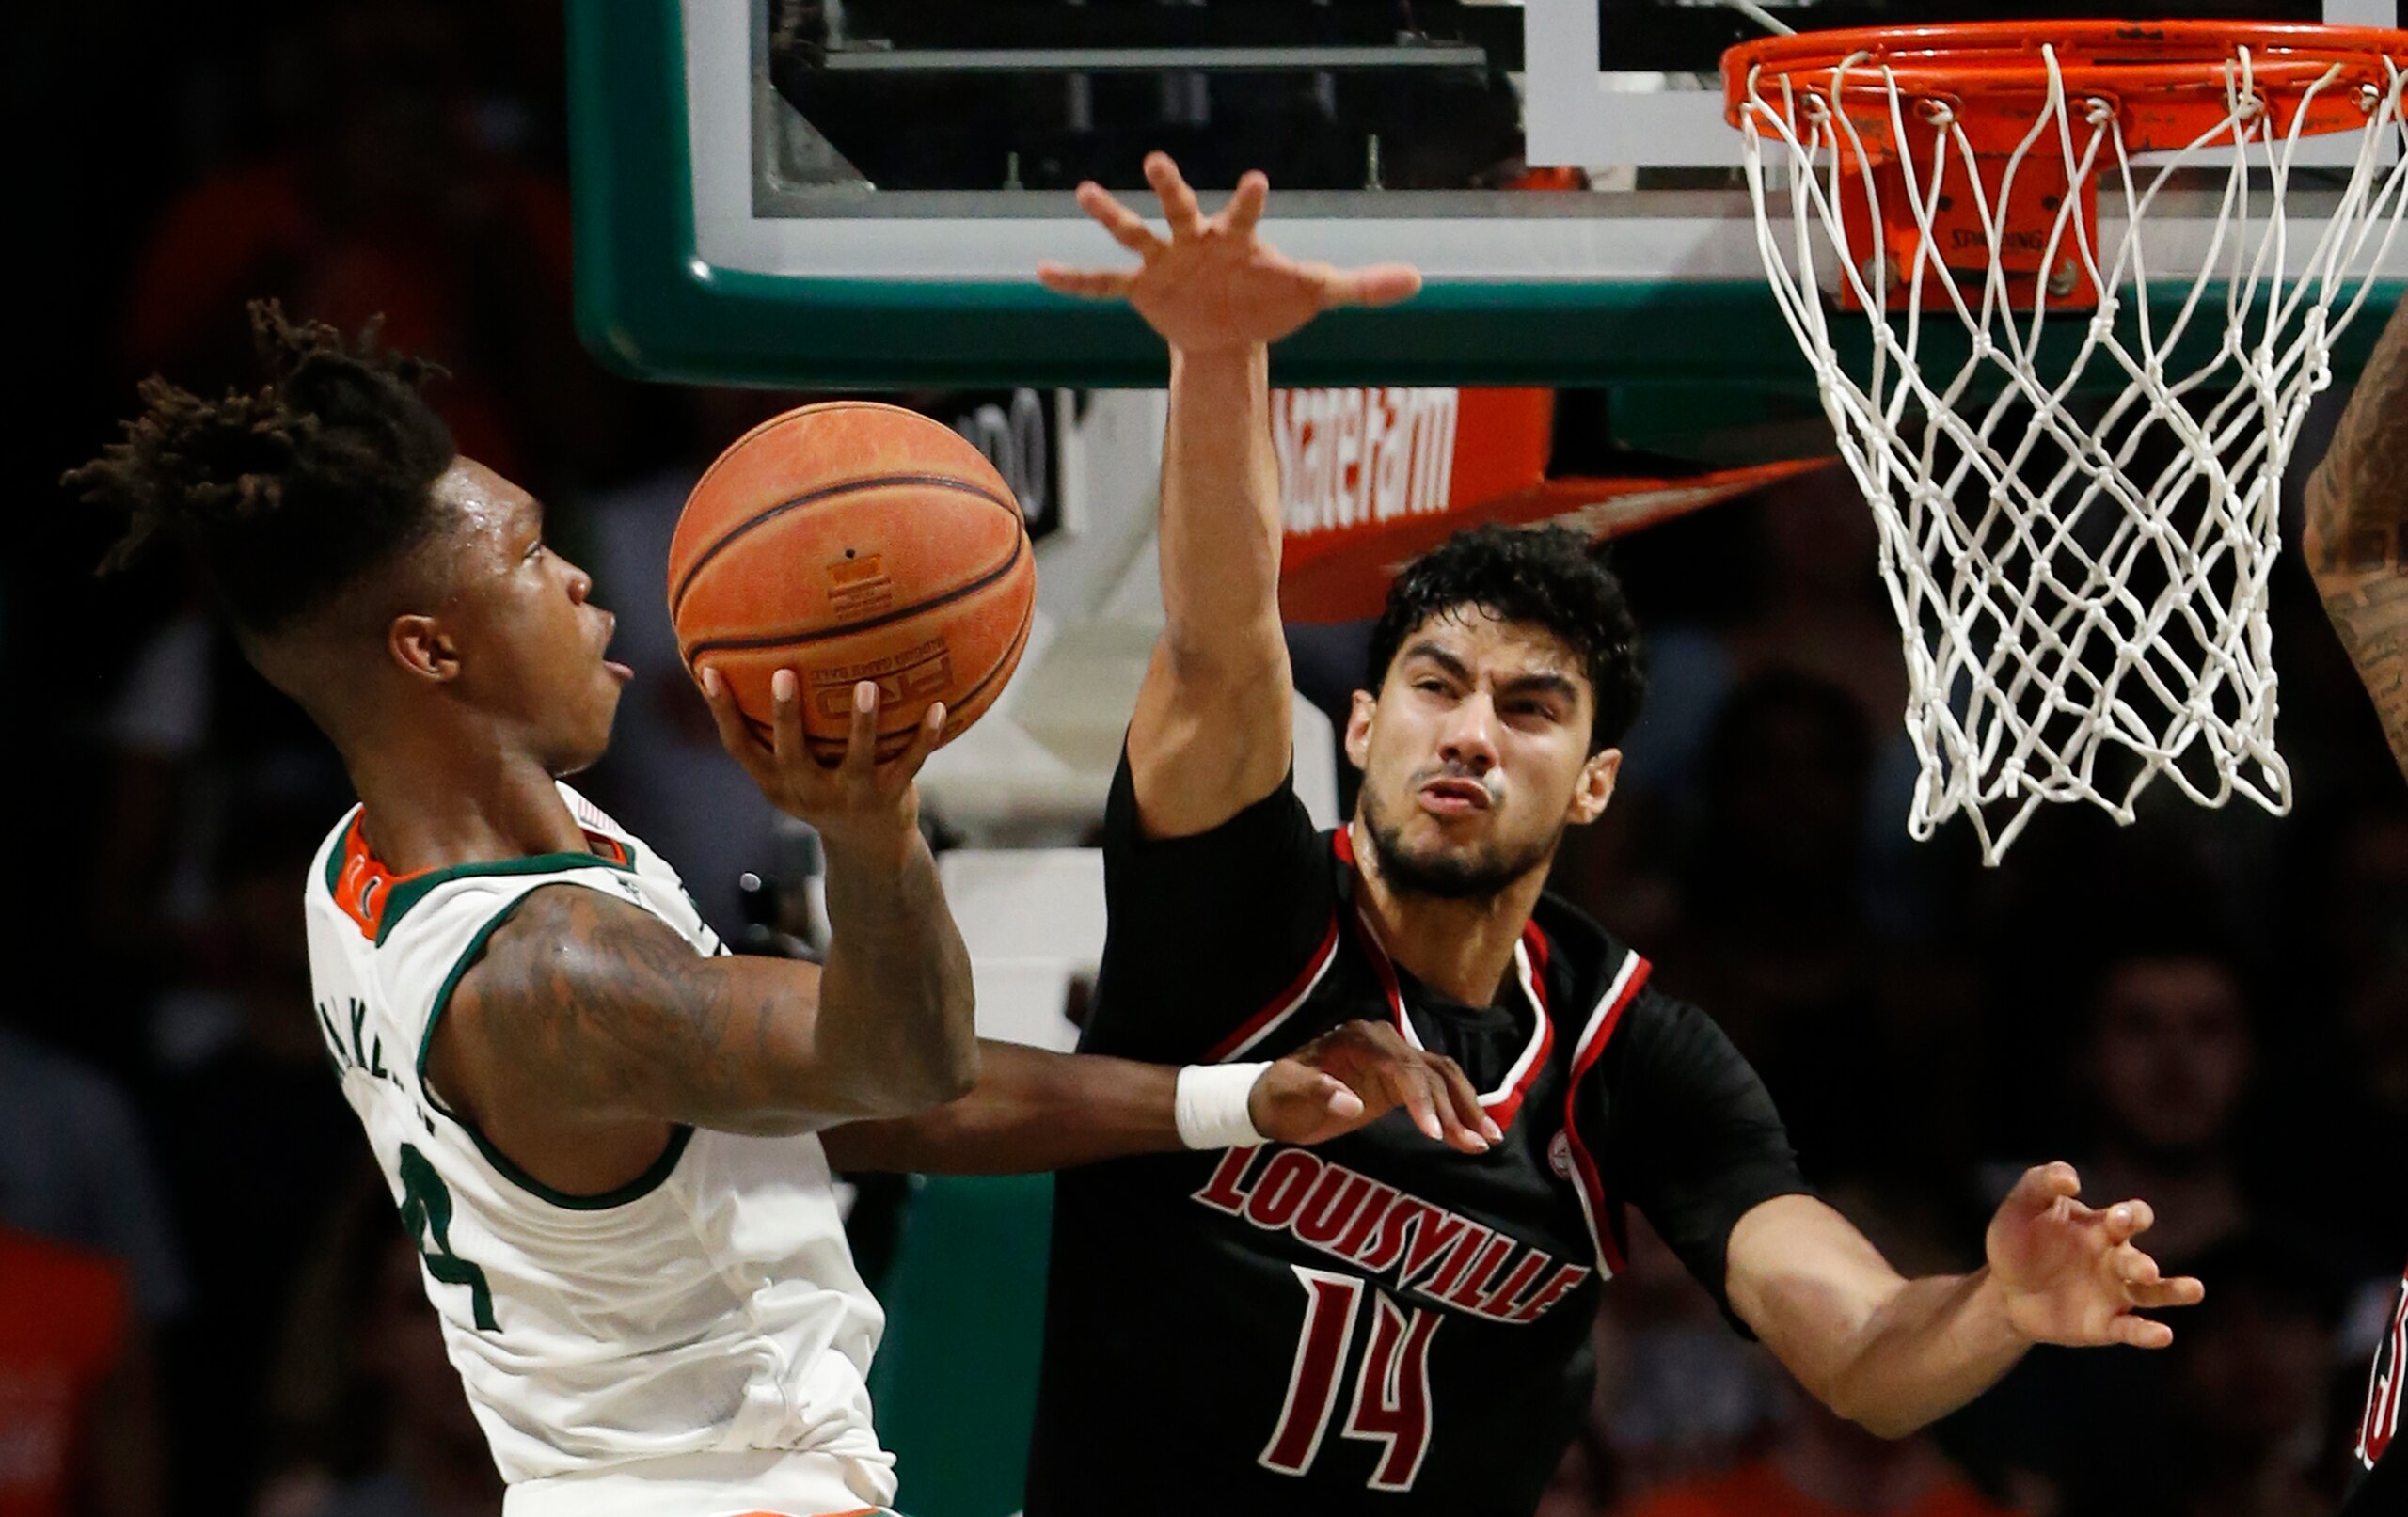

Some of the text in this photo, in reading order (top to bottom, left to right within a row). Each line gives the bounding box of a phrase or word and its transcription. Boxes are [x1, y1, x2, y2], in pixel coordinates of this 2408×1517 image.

[1951, 228, 2044, 252] SPADING
[1190, 1144, 1592, 1324] LOUISVILLE
[1257, 1263, 1445, 1492] 14
